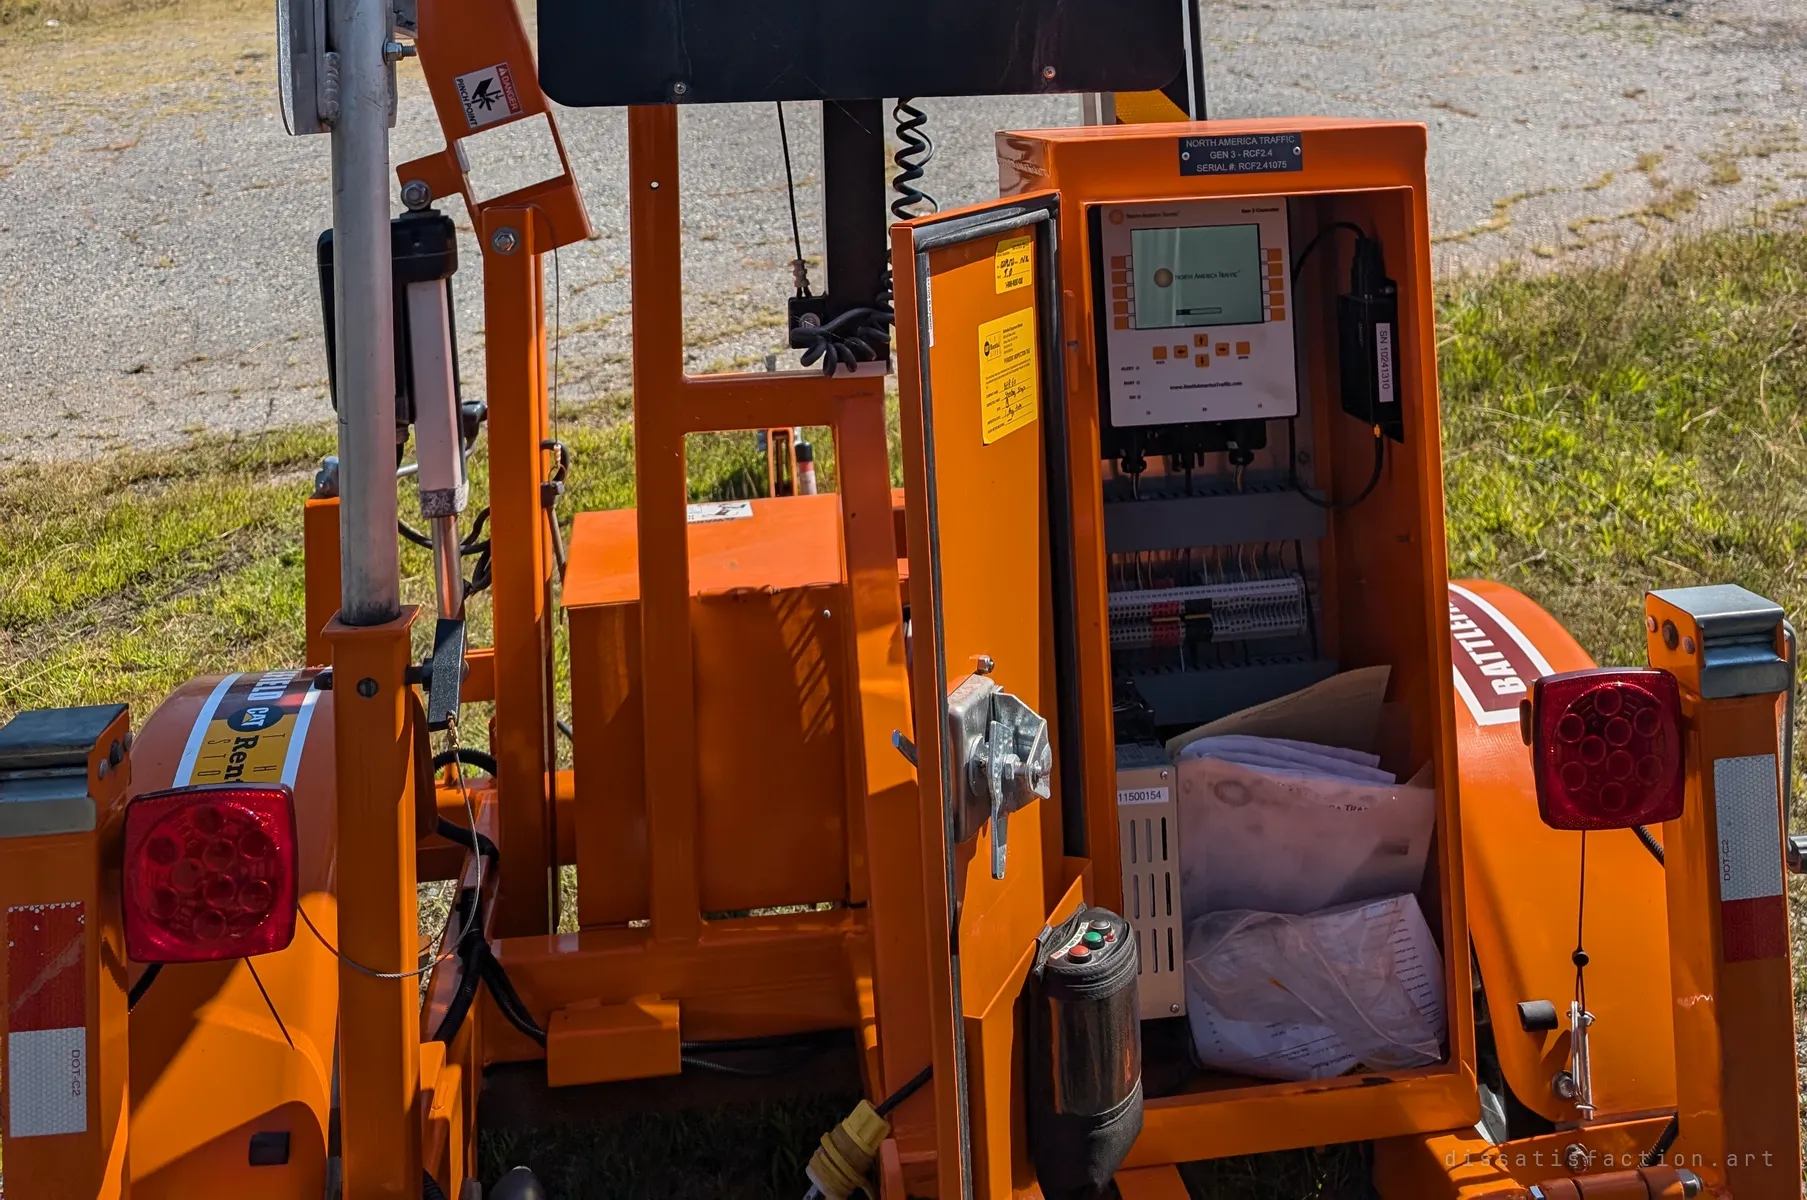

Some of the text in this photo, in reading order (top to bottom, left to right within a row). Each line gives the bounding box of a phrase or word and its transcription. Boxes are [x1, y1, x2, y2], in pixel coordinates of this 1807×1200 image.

[456, 78, 478, 125] PINCH POINT
[501, 76, 518, 110] DANGER
[1185, 135, 1295, 148] NORTH AMERICA TRAFFIC
[1209, 151, 1229, 159] GEN
[1230, 150, 1236, 159] 3
[1243, 149, 1273, 158] RCF2.4
[1196, 164, 1228, 172] SERIAL
[1239, 161, 1288, 170] RCF2.41075
[1380, 330, 1390, 390] SN 10241310
[241, 707, 269, 727] CAT
[224, 735, 259, 783] Ren
[1118, 791, 1161, 802] 11500154
[1721, 839, 1730, 881] DOT-C2
[71, 1049, 81, 1096] DOT-C2
